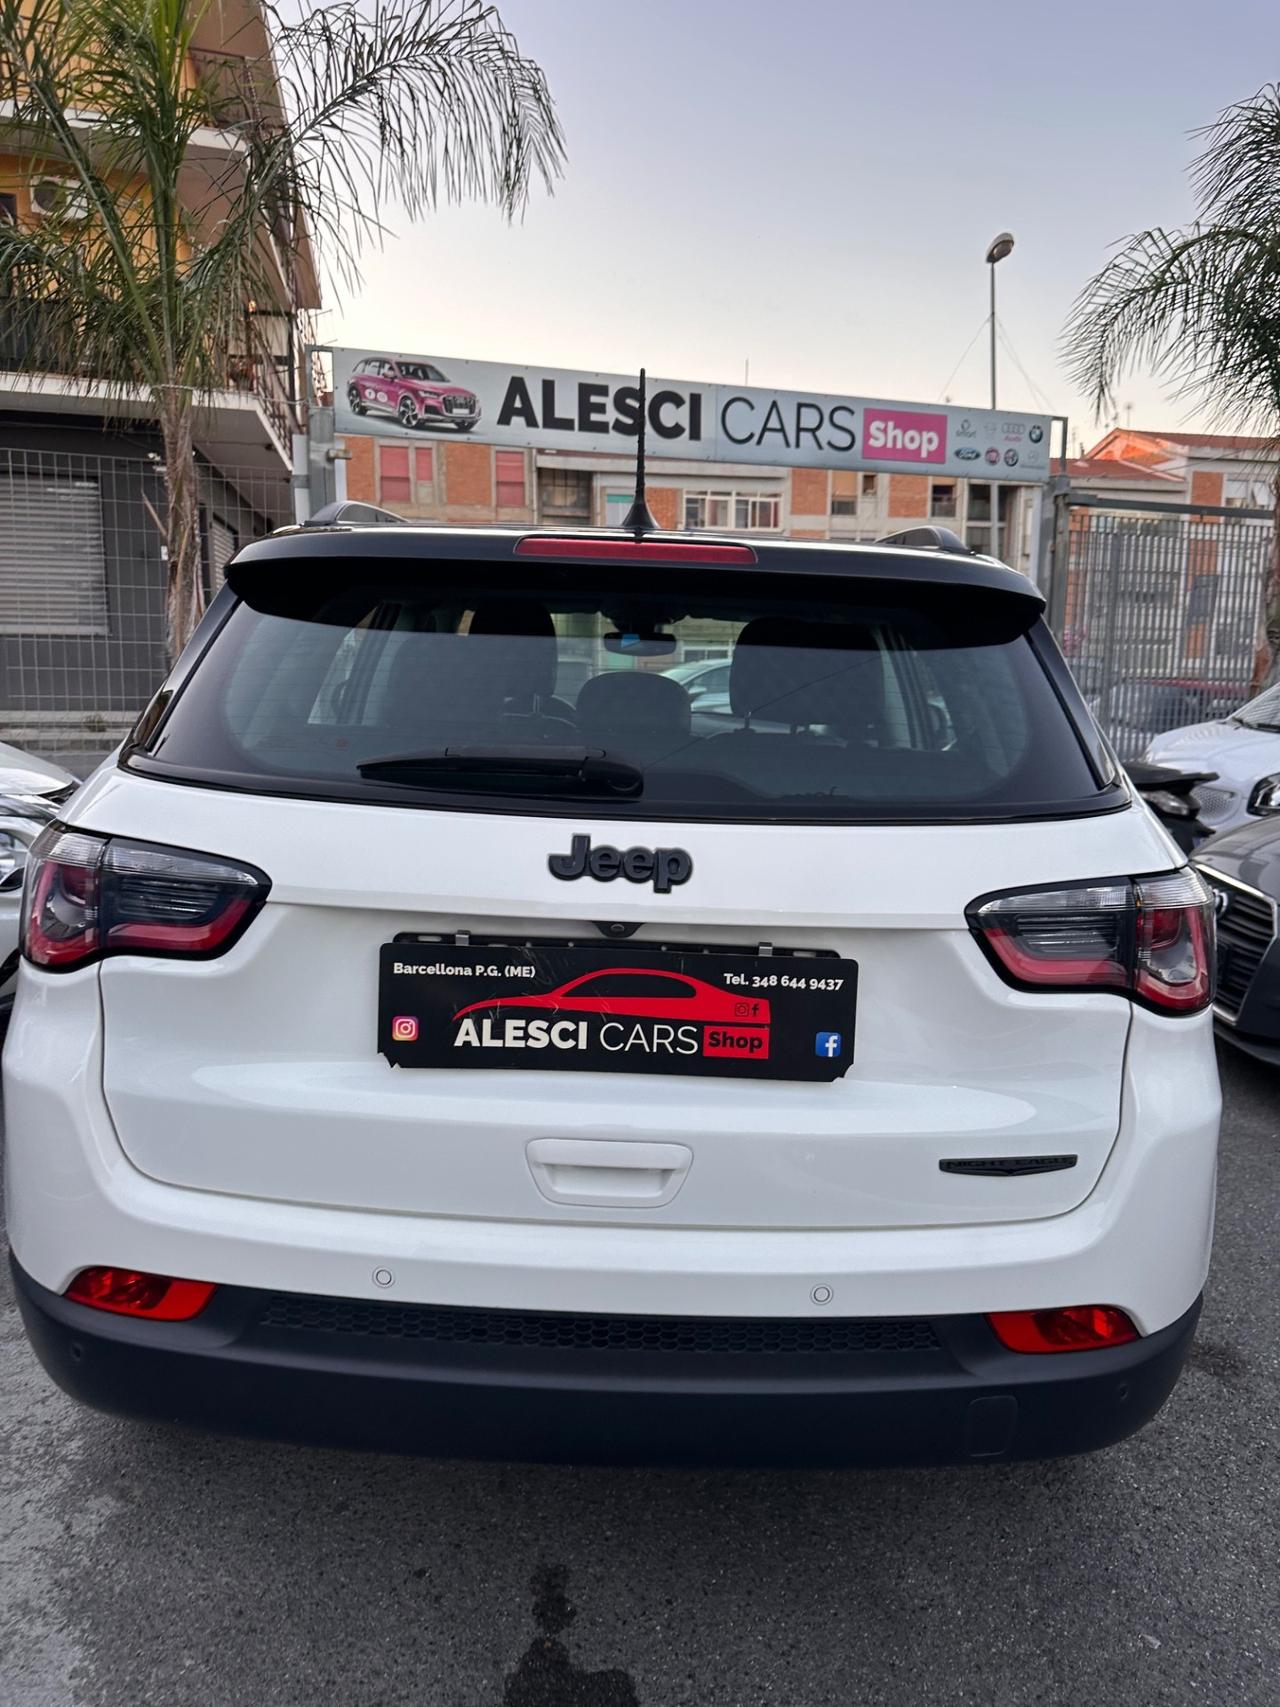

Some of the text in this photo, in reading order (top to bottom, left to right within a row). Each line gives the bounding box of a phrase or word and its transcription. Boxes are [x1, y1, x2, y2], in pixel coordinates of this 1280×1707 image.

[497, 375, 939, 459] ALESCI CARS Shop
[548, 833, 692, 894] Jeep
[393, 962, 536, 978] Barcellona P.G. (ME)
[723, 973, 844, 991] Tel. 348 644 9437
[453, 1018, 763, 1055] ALESCI CARS Shop
